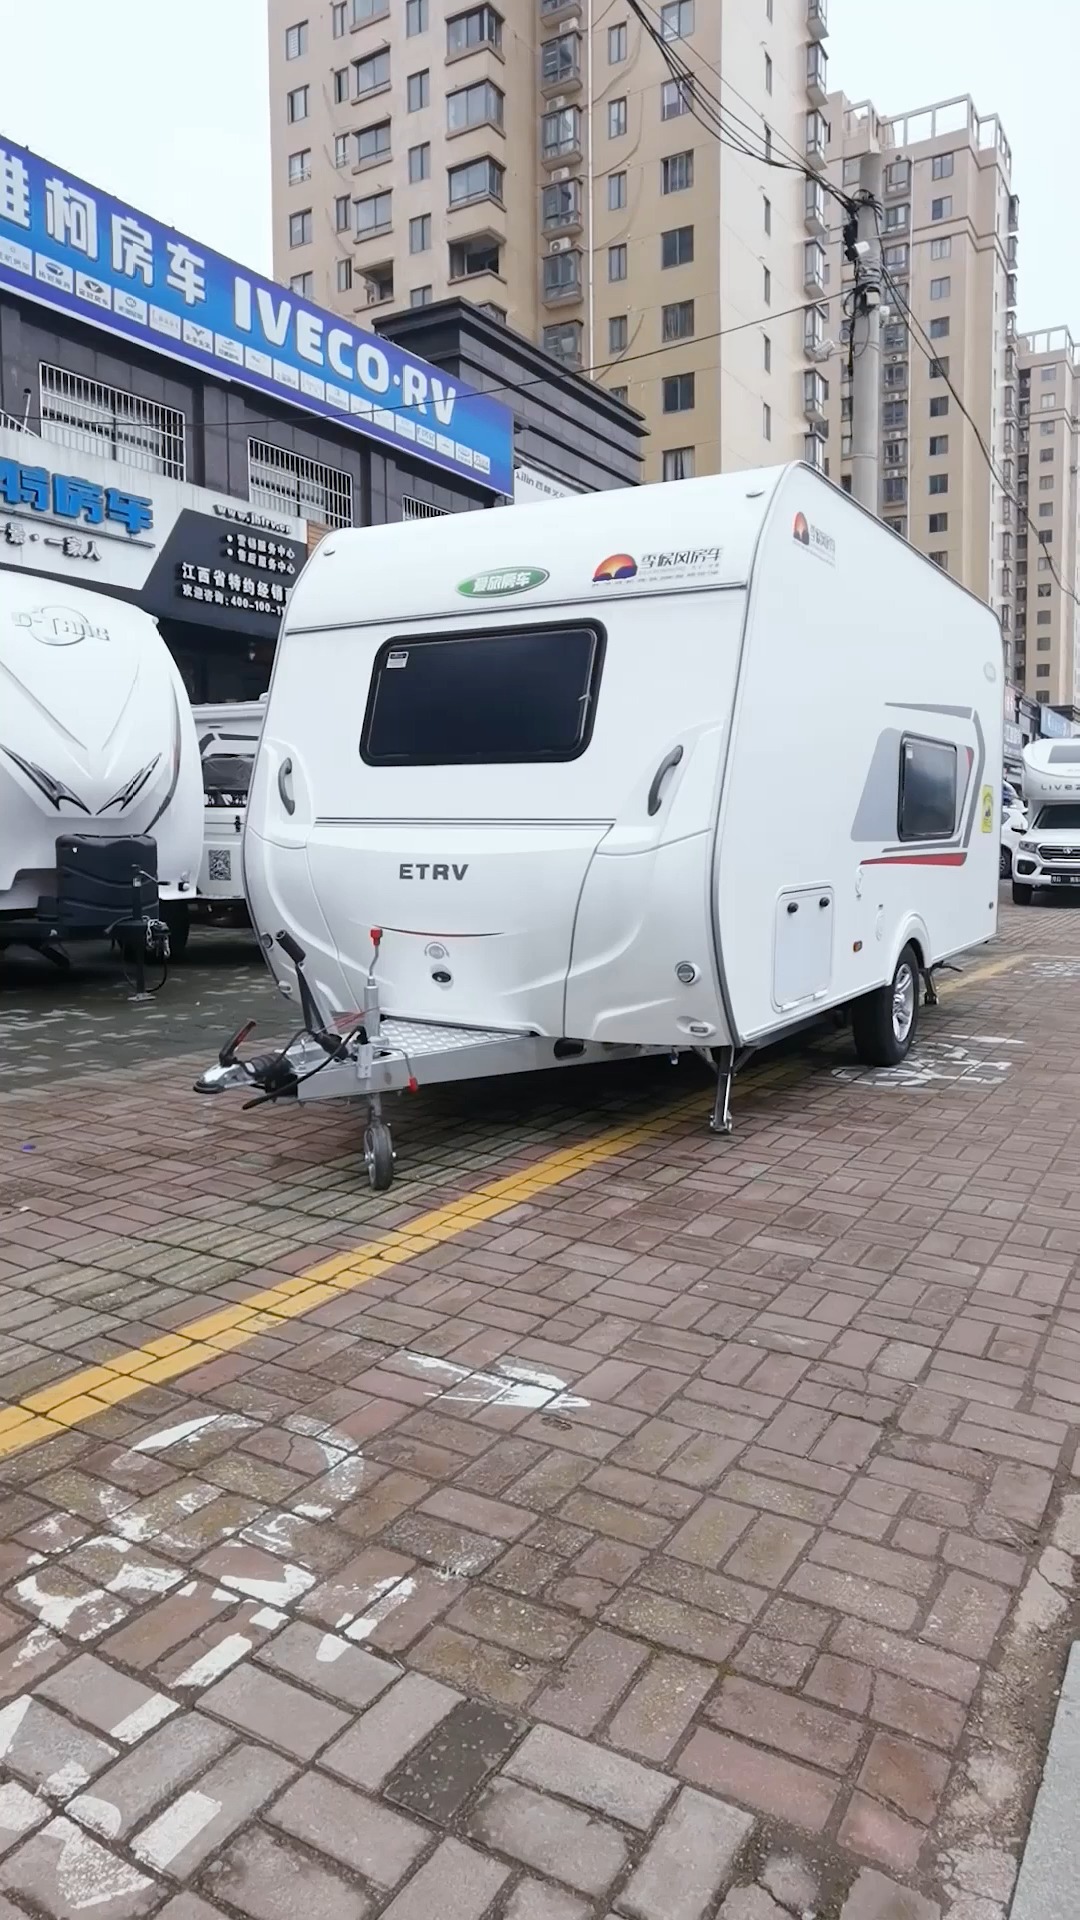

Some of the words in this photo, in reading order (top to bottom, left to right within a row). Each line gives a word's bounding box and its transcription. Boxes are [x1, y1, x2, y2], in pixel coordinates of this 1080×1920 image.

[237, 548, 296, 575] 售后服务中心
[473, 571, 532, 593] 爱旅房车
[399, 863, 469, 881] ETRV
